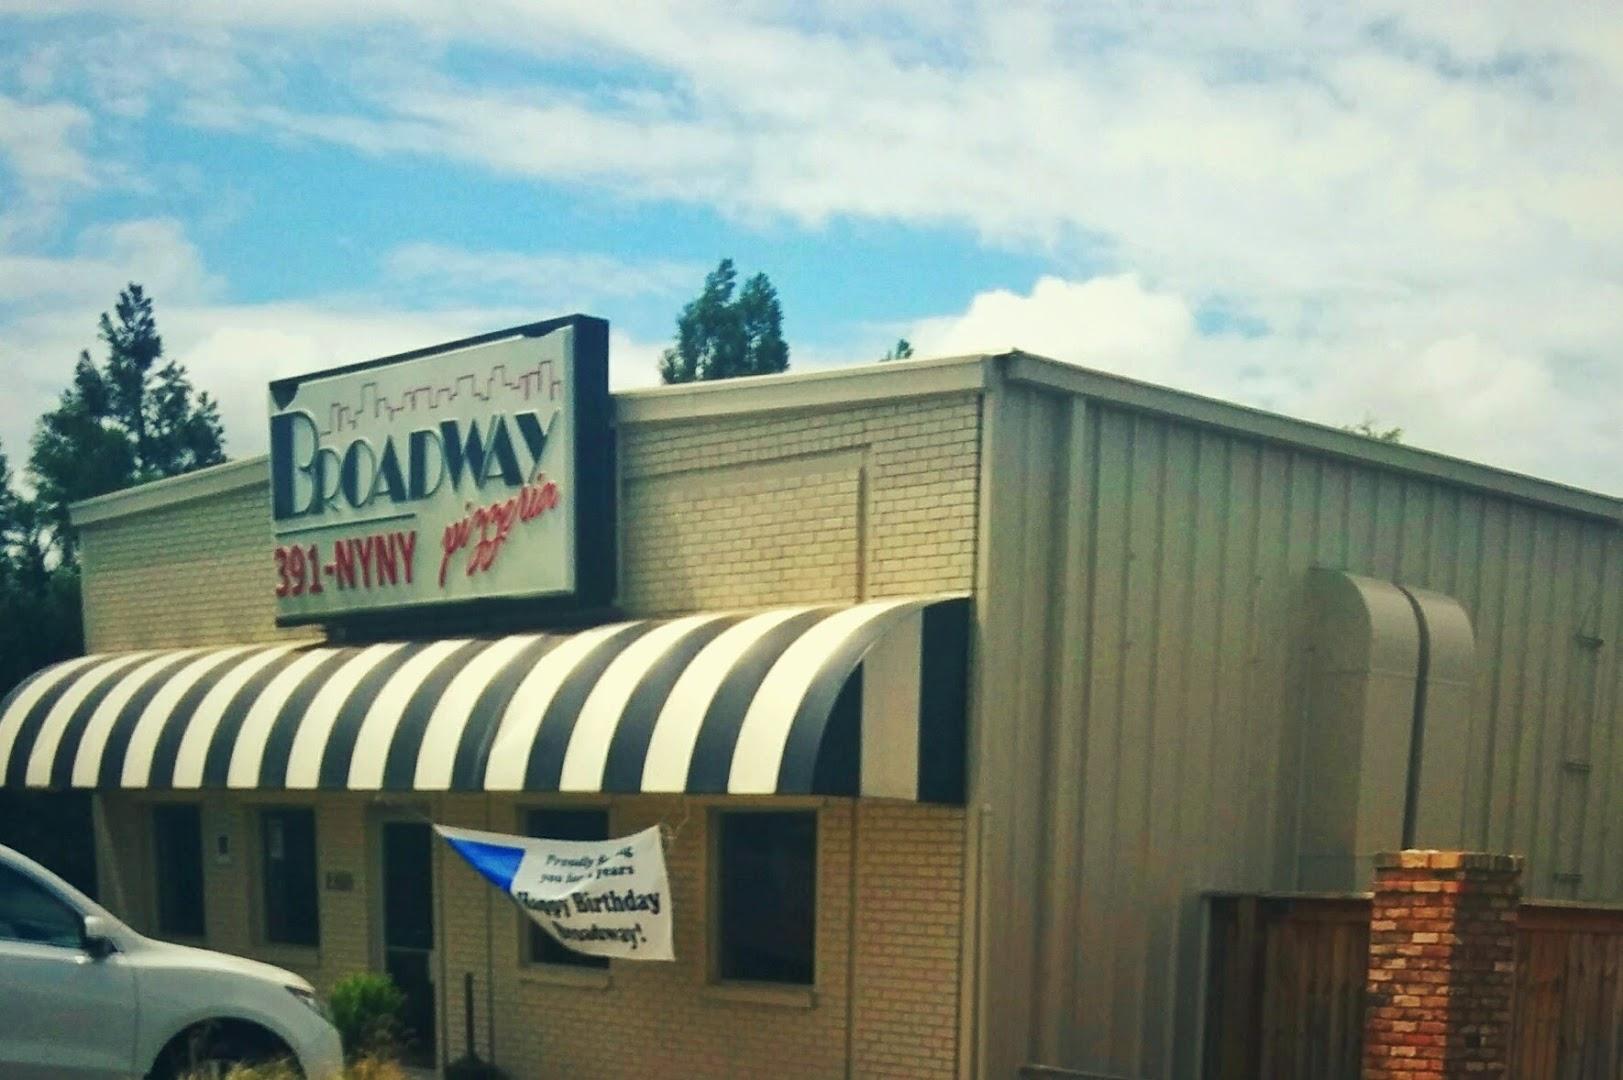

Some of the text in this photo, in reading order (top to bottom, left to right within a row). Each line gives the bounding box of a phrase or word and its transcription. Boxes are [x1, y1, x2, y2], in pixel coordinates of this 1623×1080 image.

[270, 407, 561, 521] BROADWAY
[274, 530, 417, 598] 391-NYNY
[545, 853, 595, 870] Proudly
[571, 888, 660, 915] Birthday
